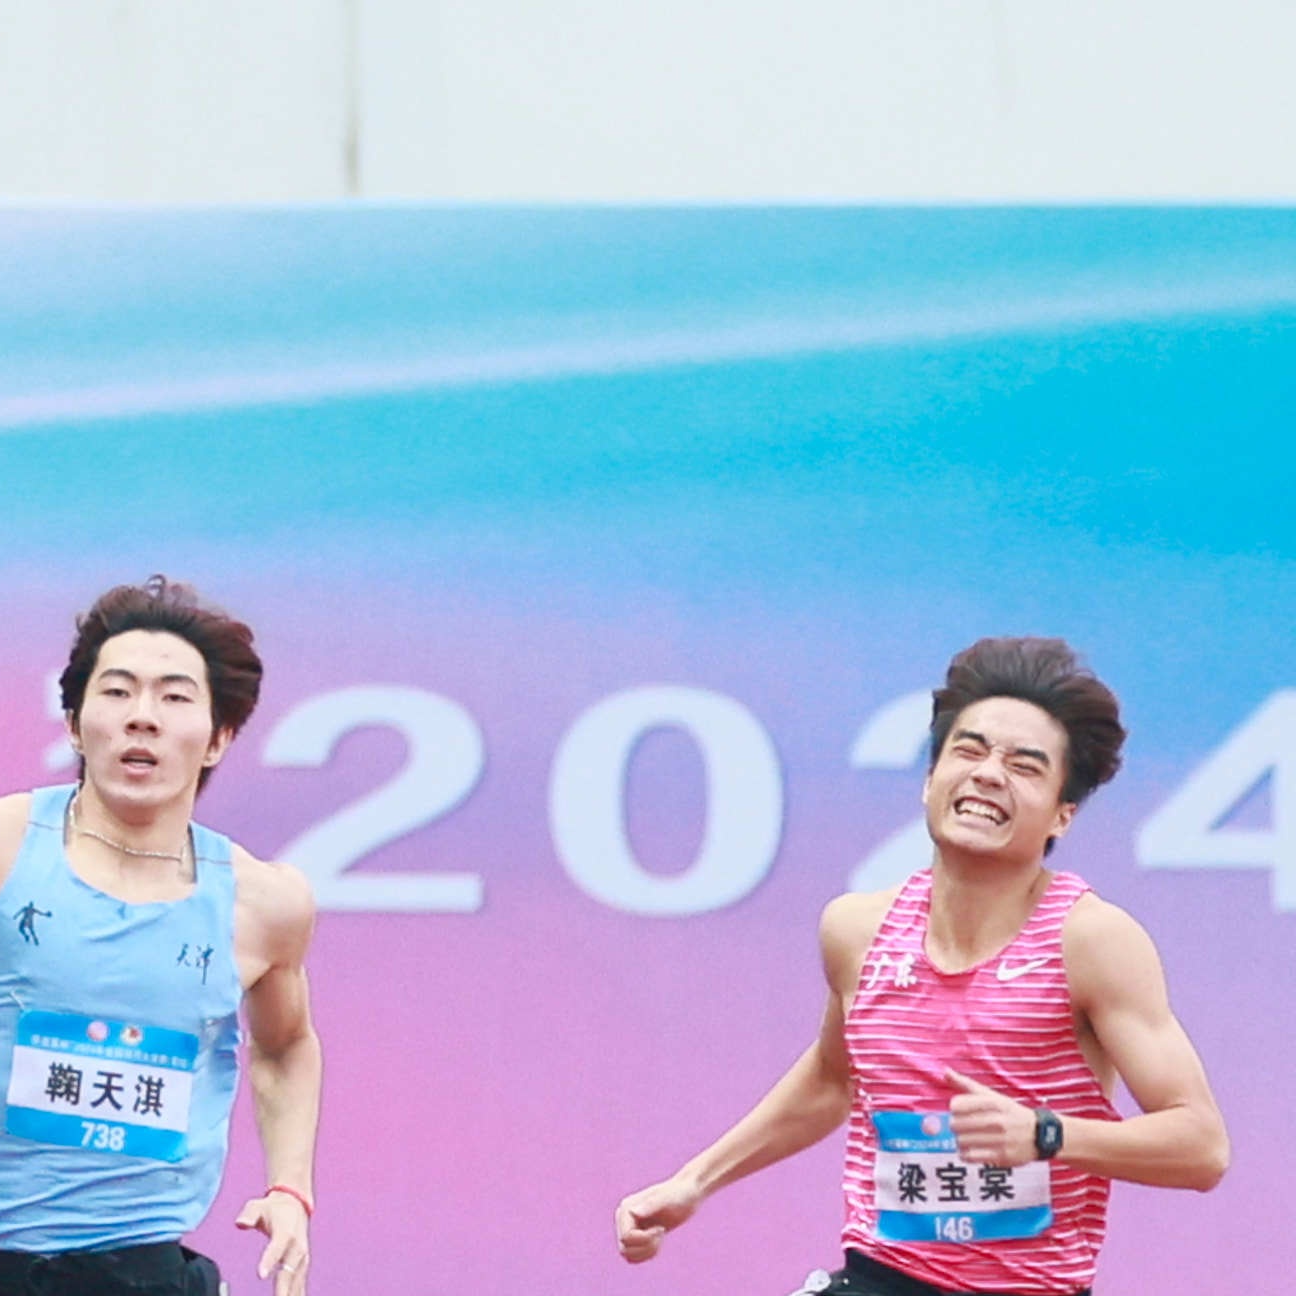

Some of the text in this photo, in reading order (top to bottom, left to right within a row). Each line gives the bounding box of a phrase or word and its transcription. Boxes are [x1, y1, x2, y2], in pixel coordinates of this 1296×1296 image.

[45, 1061, 165, 1117] 鞠天淇
[80, 1121, 126, 1151] 738
[897, 1162, 1016, 1204] 梁宝棠
[934, 1216, 973, 1240] 146
